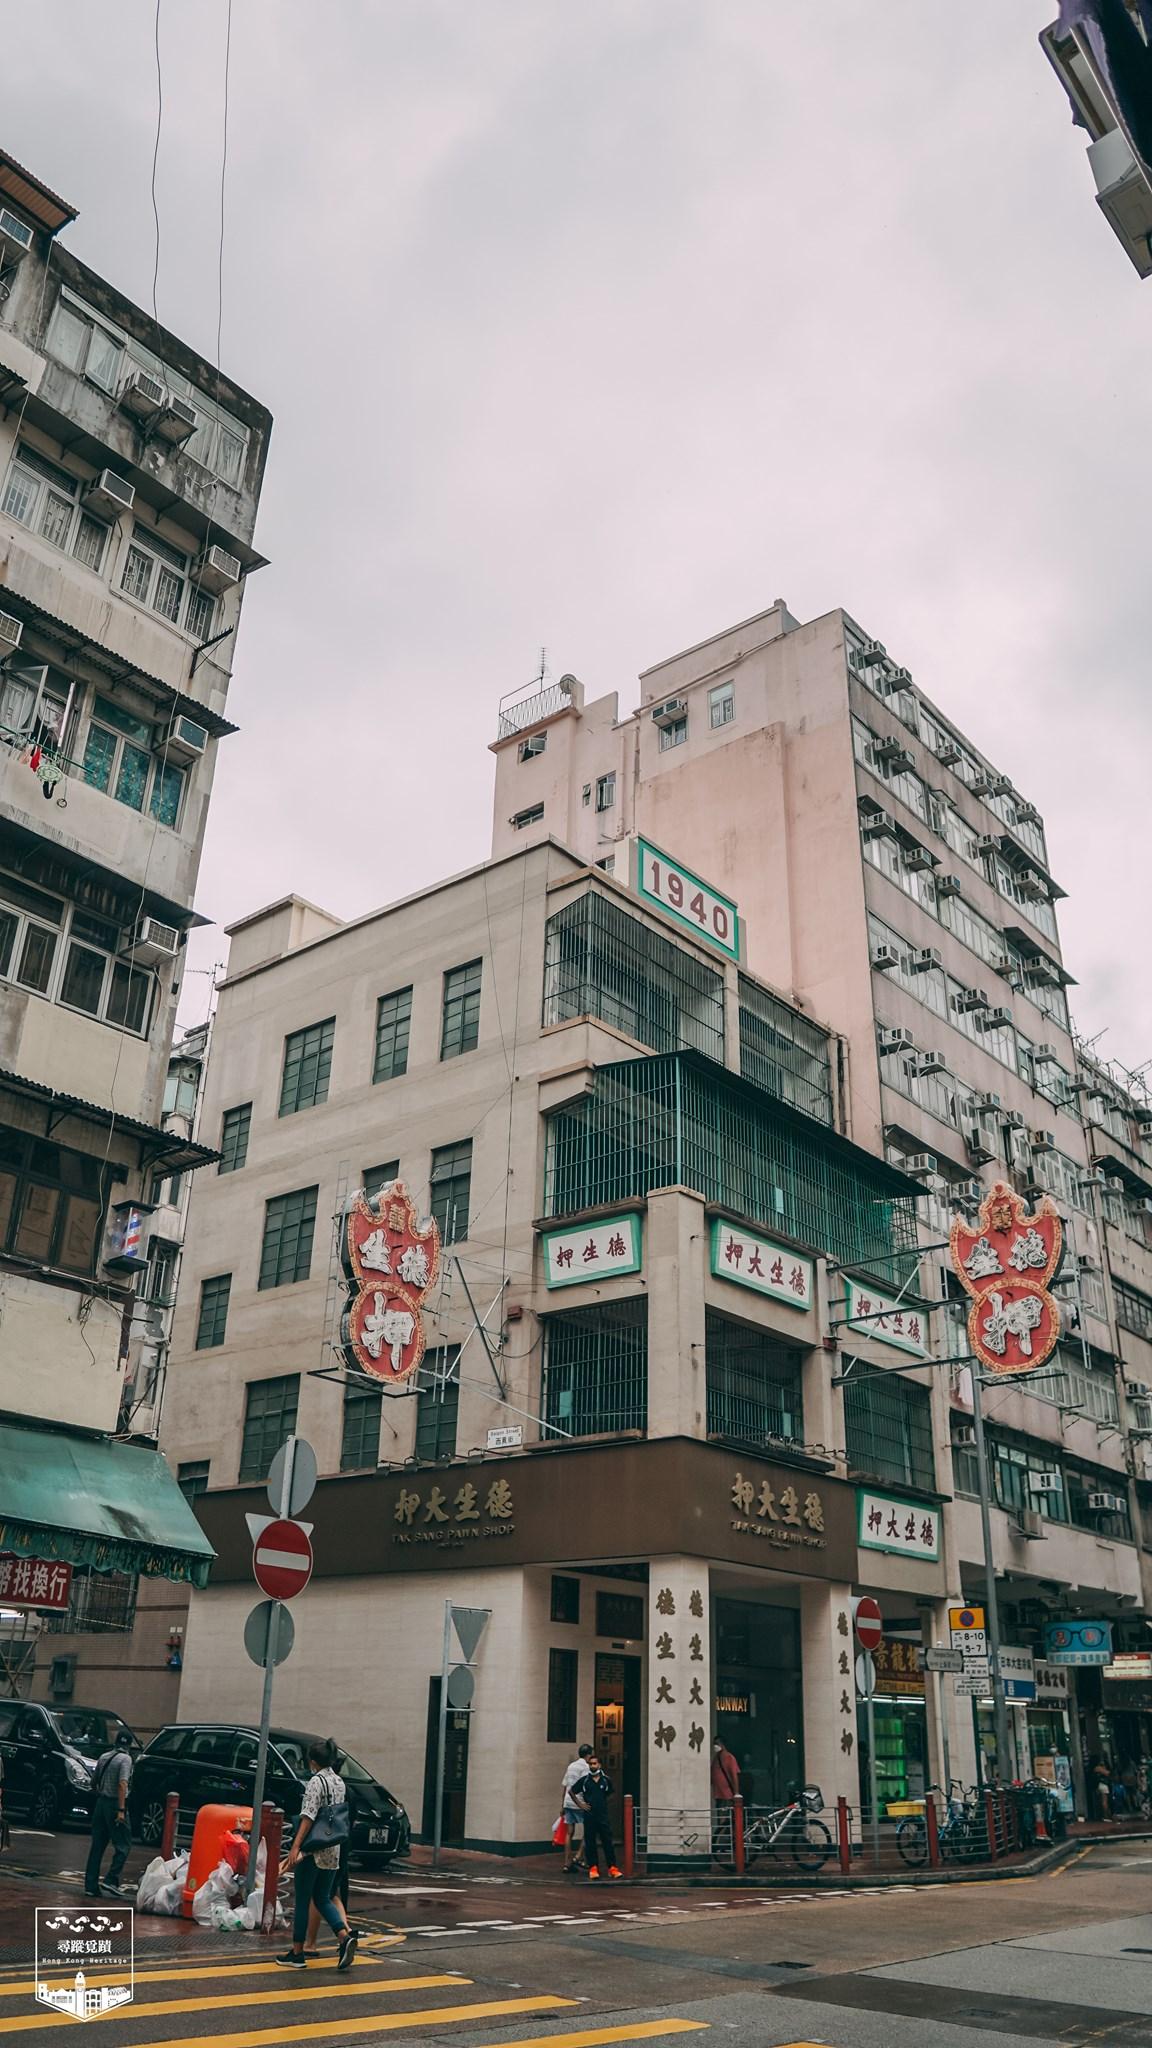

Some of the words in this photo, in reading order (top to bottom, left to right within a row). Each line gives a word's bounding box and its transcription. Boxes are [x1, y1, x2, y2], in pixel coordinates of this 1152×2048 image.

[651, 860, 728, 938] 1940
[391, 1533, 412, 1544] TAK
[414, 1530, 445, 1542] SANG
[447, 1527, 480, 1539] PAWN
[482, 1524, 515, 1537] SHOP
[654, 1588, 676, 1752] 德生大押
[688, 1589, 705, 1753] 德生大押
[837, 1611, 854, 1756] 德生大押
[964, 1632, 984, 1641] 8-10
